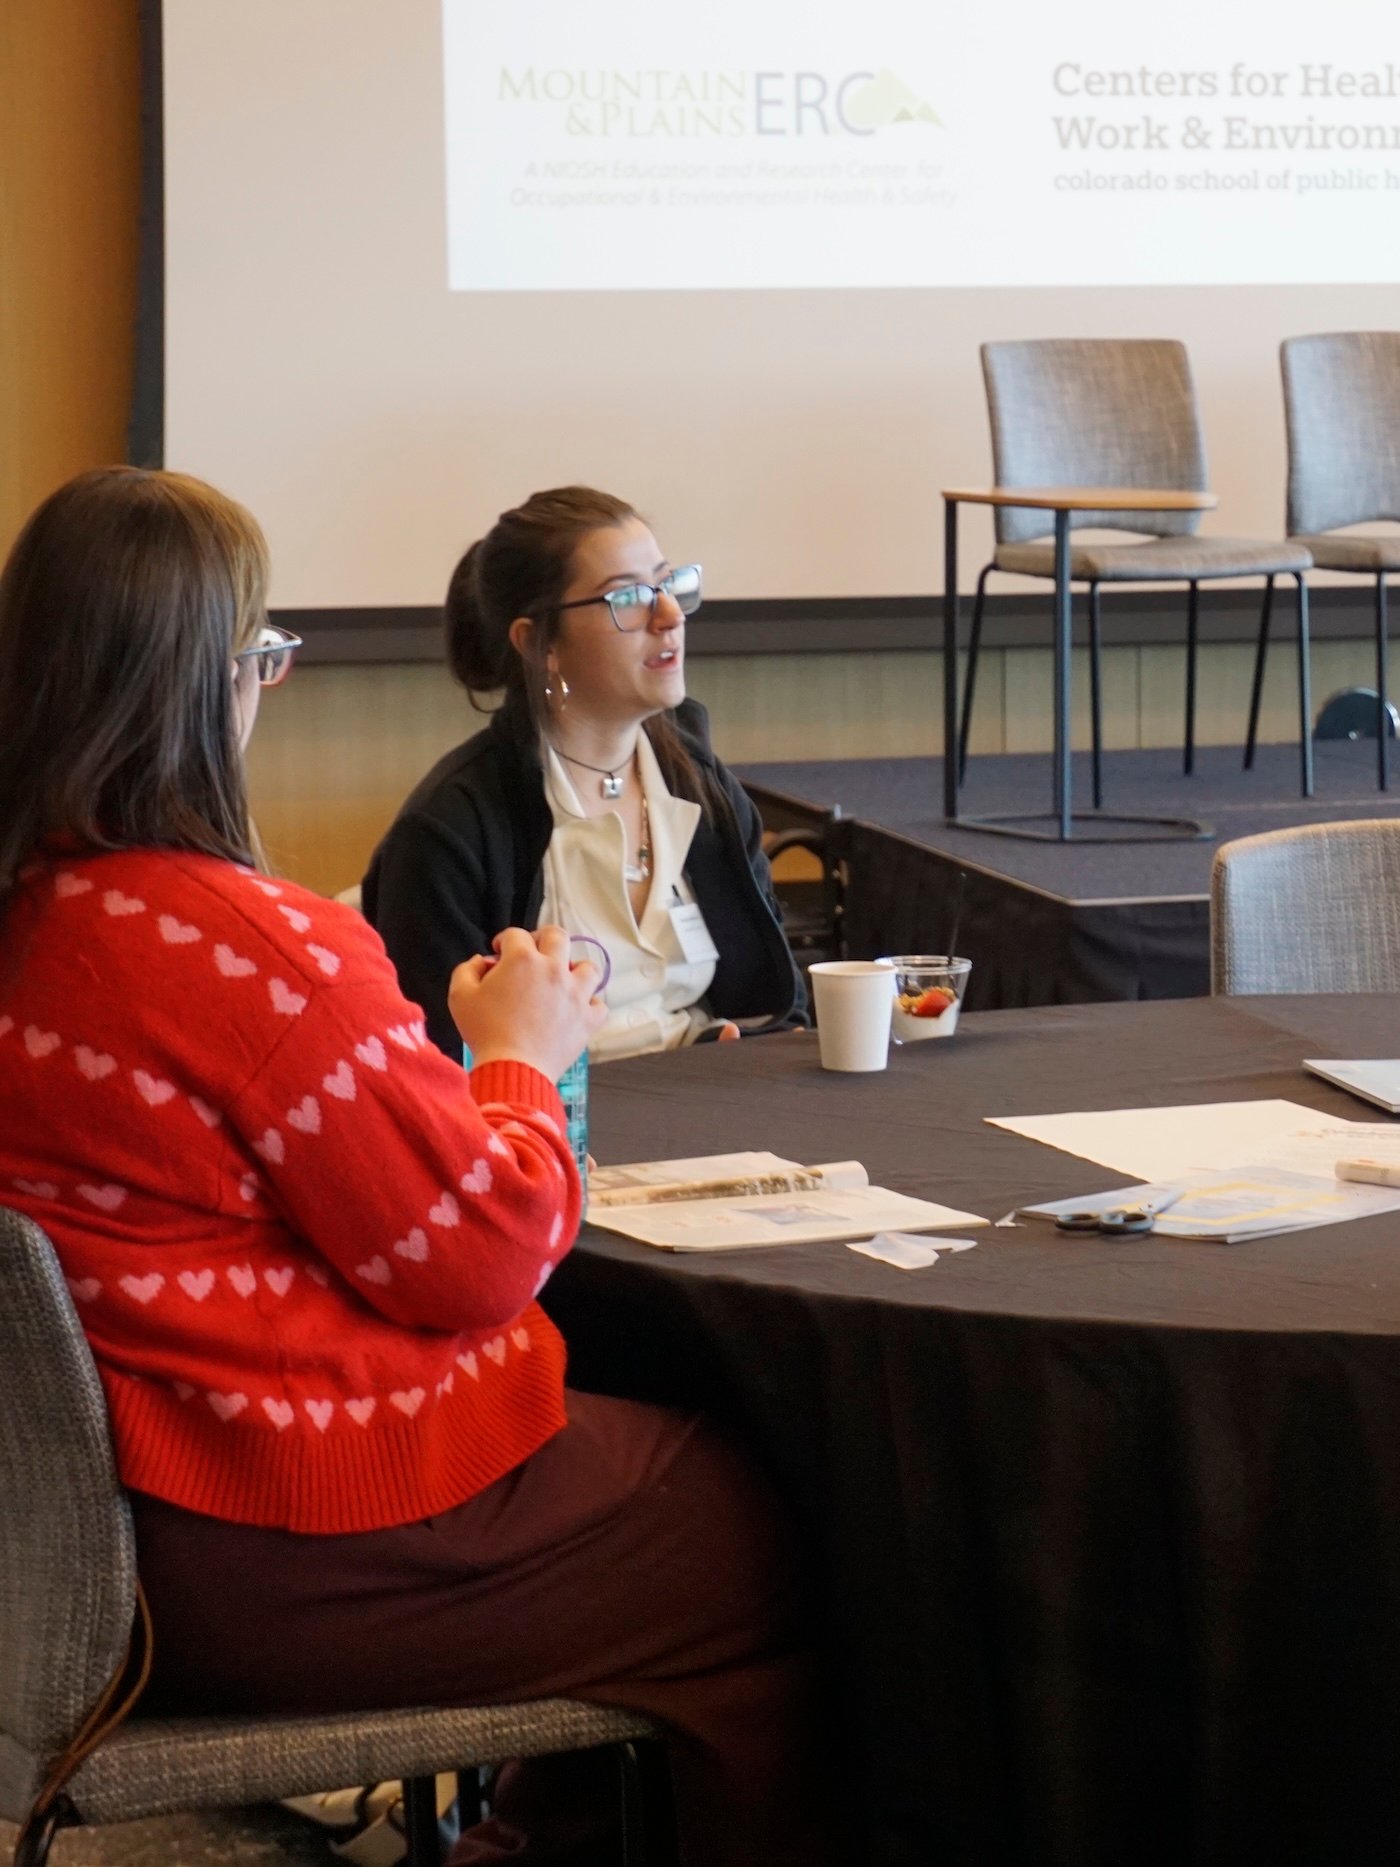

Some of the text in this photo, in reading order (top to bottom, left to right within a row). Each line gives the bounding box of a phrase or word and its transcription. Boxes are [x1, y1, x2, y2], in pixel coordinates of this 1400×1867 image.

[498, 65, 746, 101] MOUNTAIN
[1051, 61, 1219, 98] Centers
[1229, 62, 1289, 98] for
[754, 71, 877, 136] ERC
[1050, 115, 1170, 151] Work
[1180, 115, 1212, 151] &
[523, 158, 944, 180] A NIOSH Education and Research Center for
[1053, 168, 1169, 191] colorado
[1174, 168, 1260, 191] school
[1265, 168, 1292, 191] of
[1295, 168, 1379, 197] public
[507, 186, 959, 212] Occupational & Environmental Health & Safety
